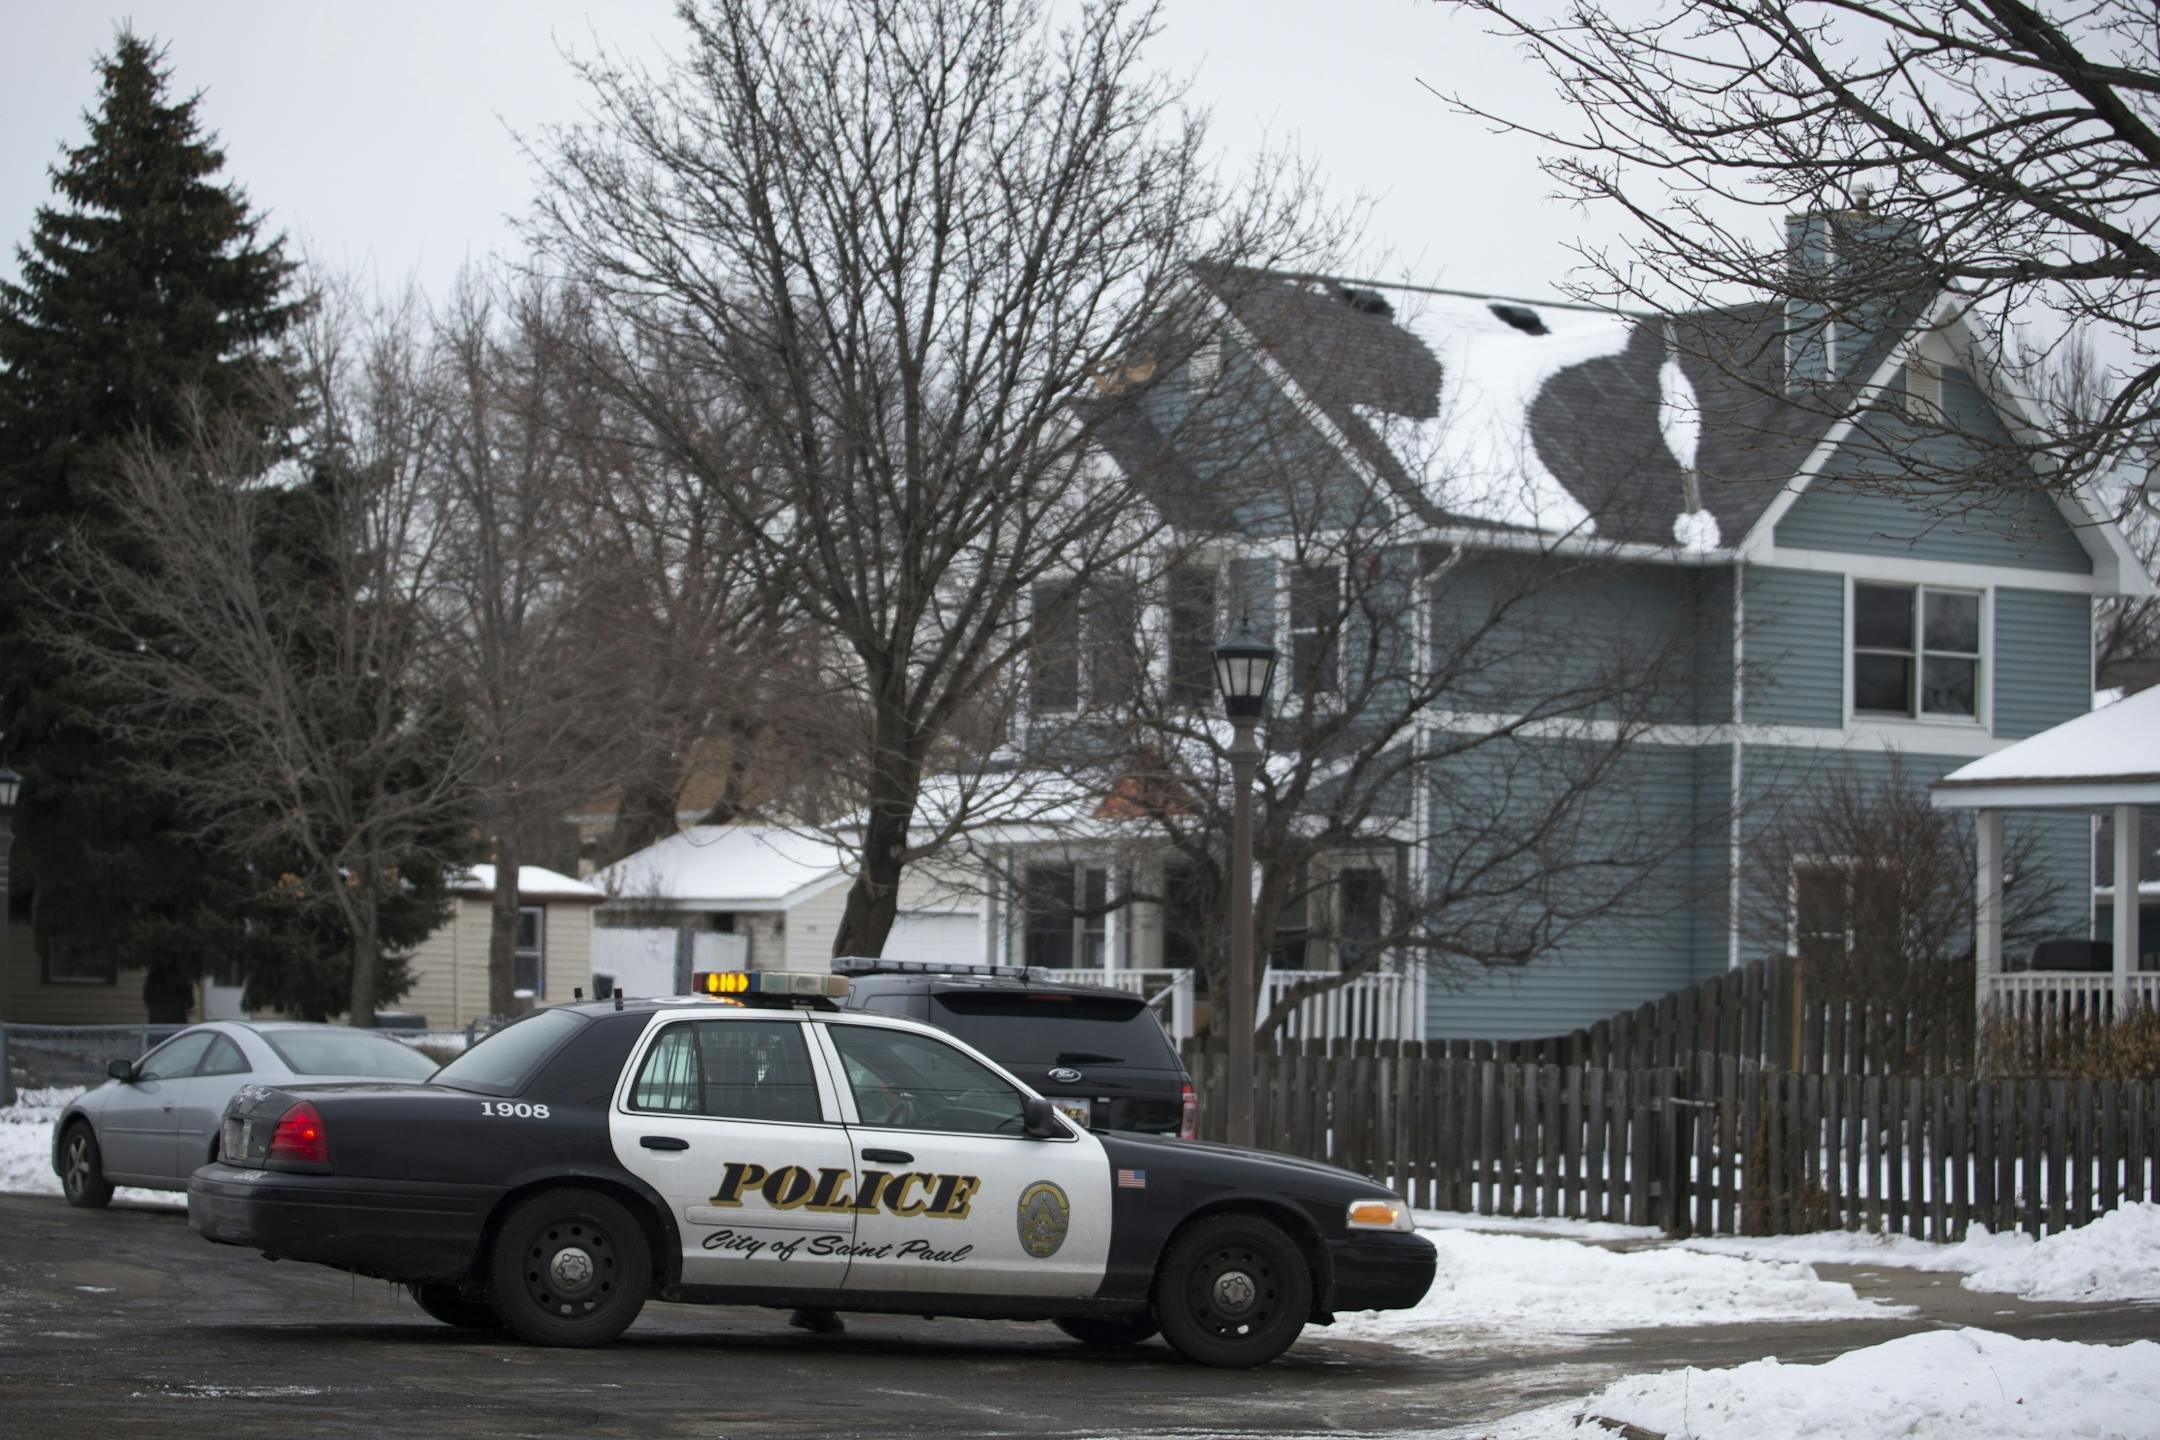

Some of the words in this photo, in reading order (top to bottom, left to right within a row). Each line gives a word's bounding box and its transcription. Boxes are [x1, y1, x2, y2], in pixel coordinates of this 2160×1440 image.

[481, 1102, 550, 1119] 1908
[708, 1162, 981, 1220] POLICE
[702, 1230, 766, 1259] City
[771, 1236, 805, 1262] of
[807, 1235, 891, 1260] Saint
[896, 1239, 973, 1262] Paul
